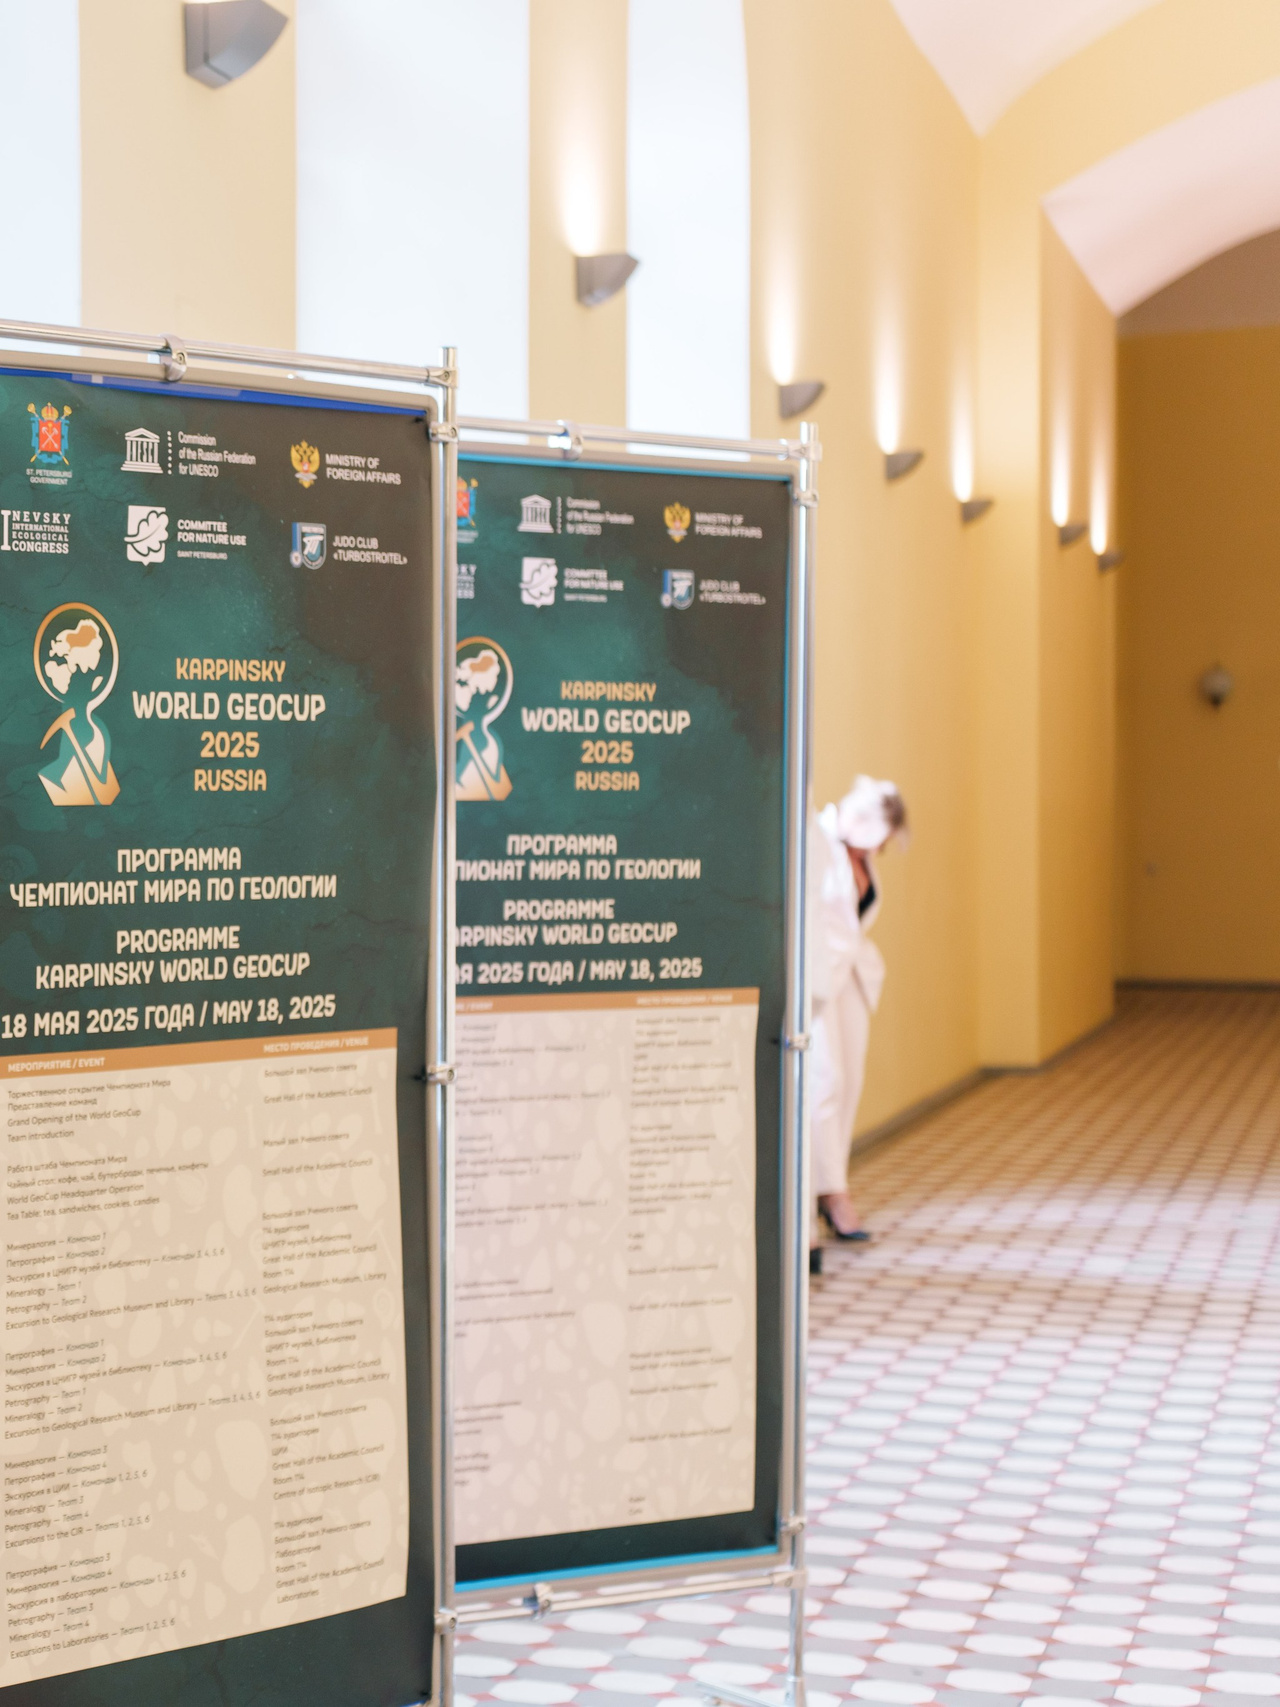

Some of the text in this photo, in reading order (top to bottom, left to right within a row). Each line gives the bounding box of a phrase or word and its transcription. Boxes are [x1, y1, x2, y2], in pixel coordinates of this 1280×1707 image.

[325, 453, 379, 470] MINISTRY OF
[326, 467, 401, 485] FOREIGN AFFAIRS
[11, 522, 69, 533] INTERNATIONAL
[12, 510, 71, 525] NEVSKY
[11, 530, 69, 544] ECOLOGICAL
[11, 540, 69, 554] CONGRESS
[176, 657, 285, 682] KARPINSKY
[561, 680, 656, 701] KARPINSKY
[132, 690, 326, 721] WORLD GEOCUP
[521, 707, 690, 734] WORLD GEOCUP
[200, 731, 260, 758] 2025
[581, 740, 634, 763] 2025
[194, 769, 267, 791] RUSSIA
[575, 771, 639, 790] RUSSIA
[507, 834, 617, 855] ПРОГРАММА
[117, 846, 241, 873] ПРОГРАММА
[456, 859, 700, 881] ПИОНАТ МИРА ПО ГЕОЛОГИИ
[9, 874, 337, 907] ЧЕМПИОНАТ МИРА ПО ГЕОЛОГИИ
[504, 899, 614, 920] PROGRAMME
[116, 925, 240, 954] PROGRAMME
[456, 922, 677, 947] RPINSKY WORLD GEOCUP
[35, 952, 310, 989] KARPINSKY WORLD GEOCUP
[477, 962, 523, 984] 2025
[527, 960, 574, 985] ГОДА
[578, 960, 586, 982] /
[589, 959, 626, 980] MAY
[630, 958, 654, 980] 18,
[659, 957, 702, 979] 2025
[1, 994, 336, 1039] 18 МАЯ 2025 ГОДА / MAY 18, 2025
[7, 1108, 141, 1127] Grand Opening of the World GeoCup
